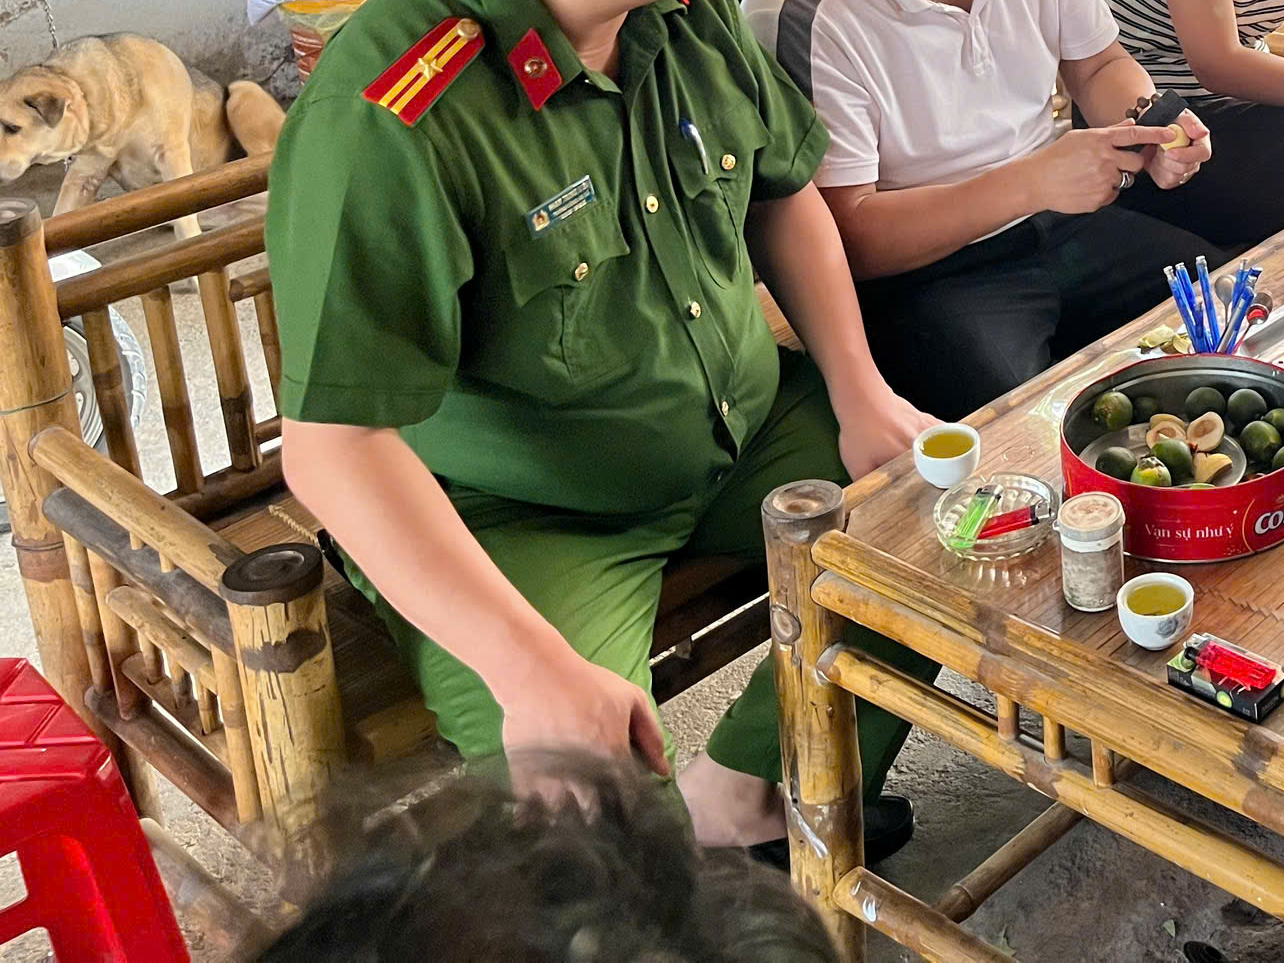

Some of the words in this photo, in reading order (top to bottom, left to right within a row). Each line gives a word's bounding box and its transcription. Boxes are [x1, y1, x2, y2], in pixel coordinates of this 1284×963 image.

[1145, 523, 1171, 540] Vạn
[1175, 527, 1191, 541] sự
[1195, 526, 1224, 539] như
